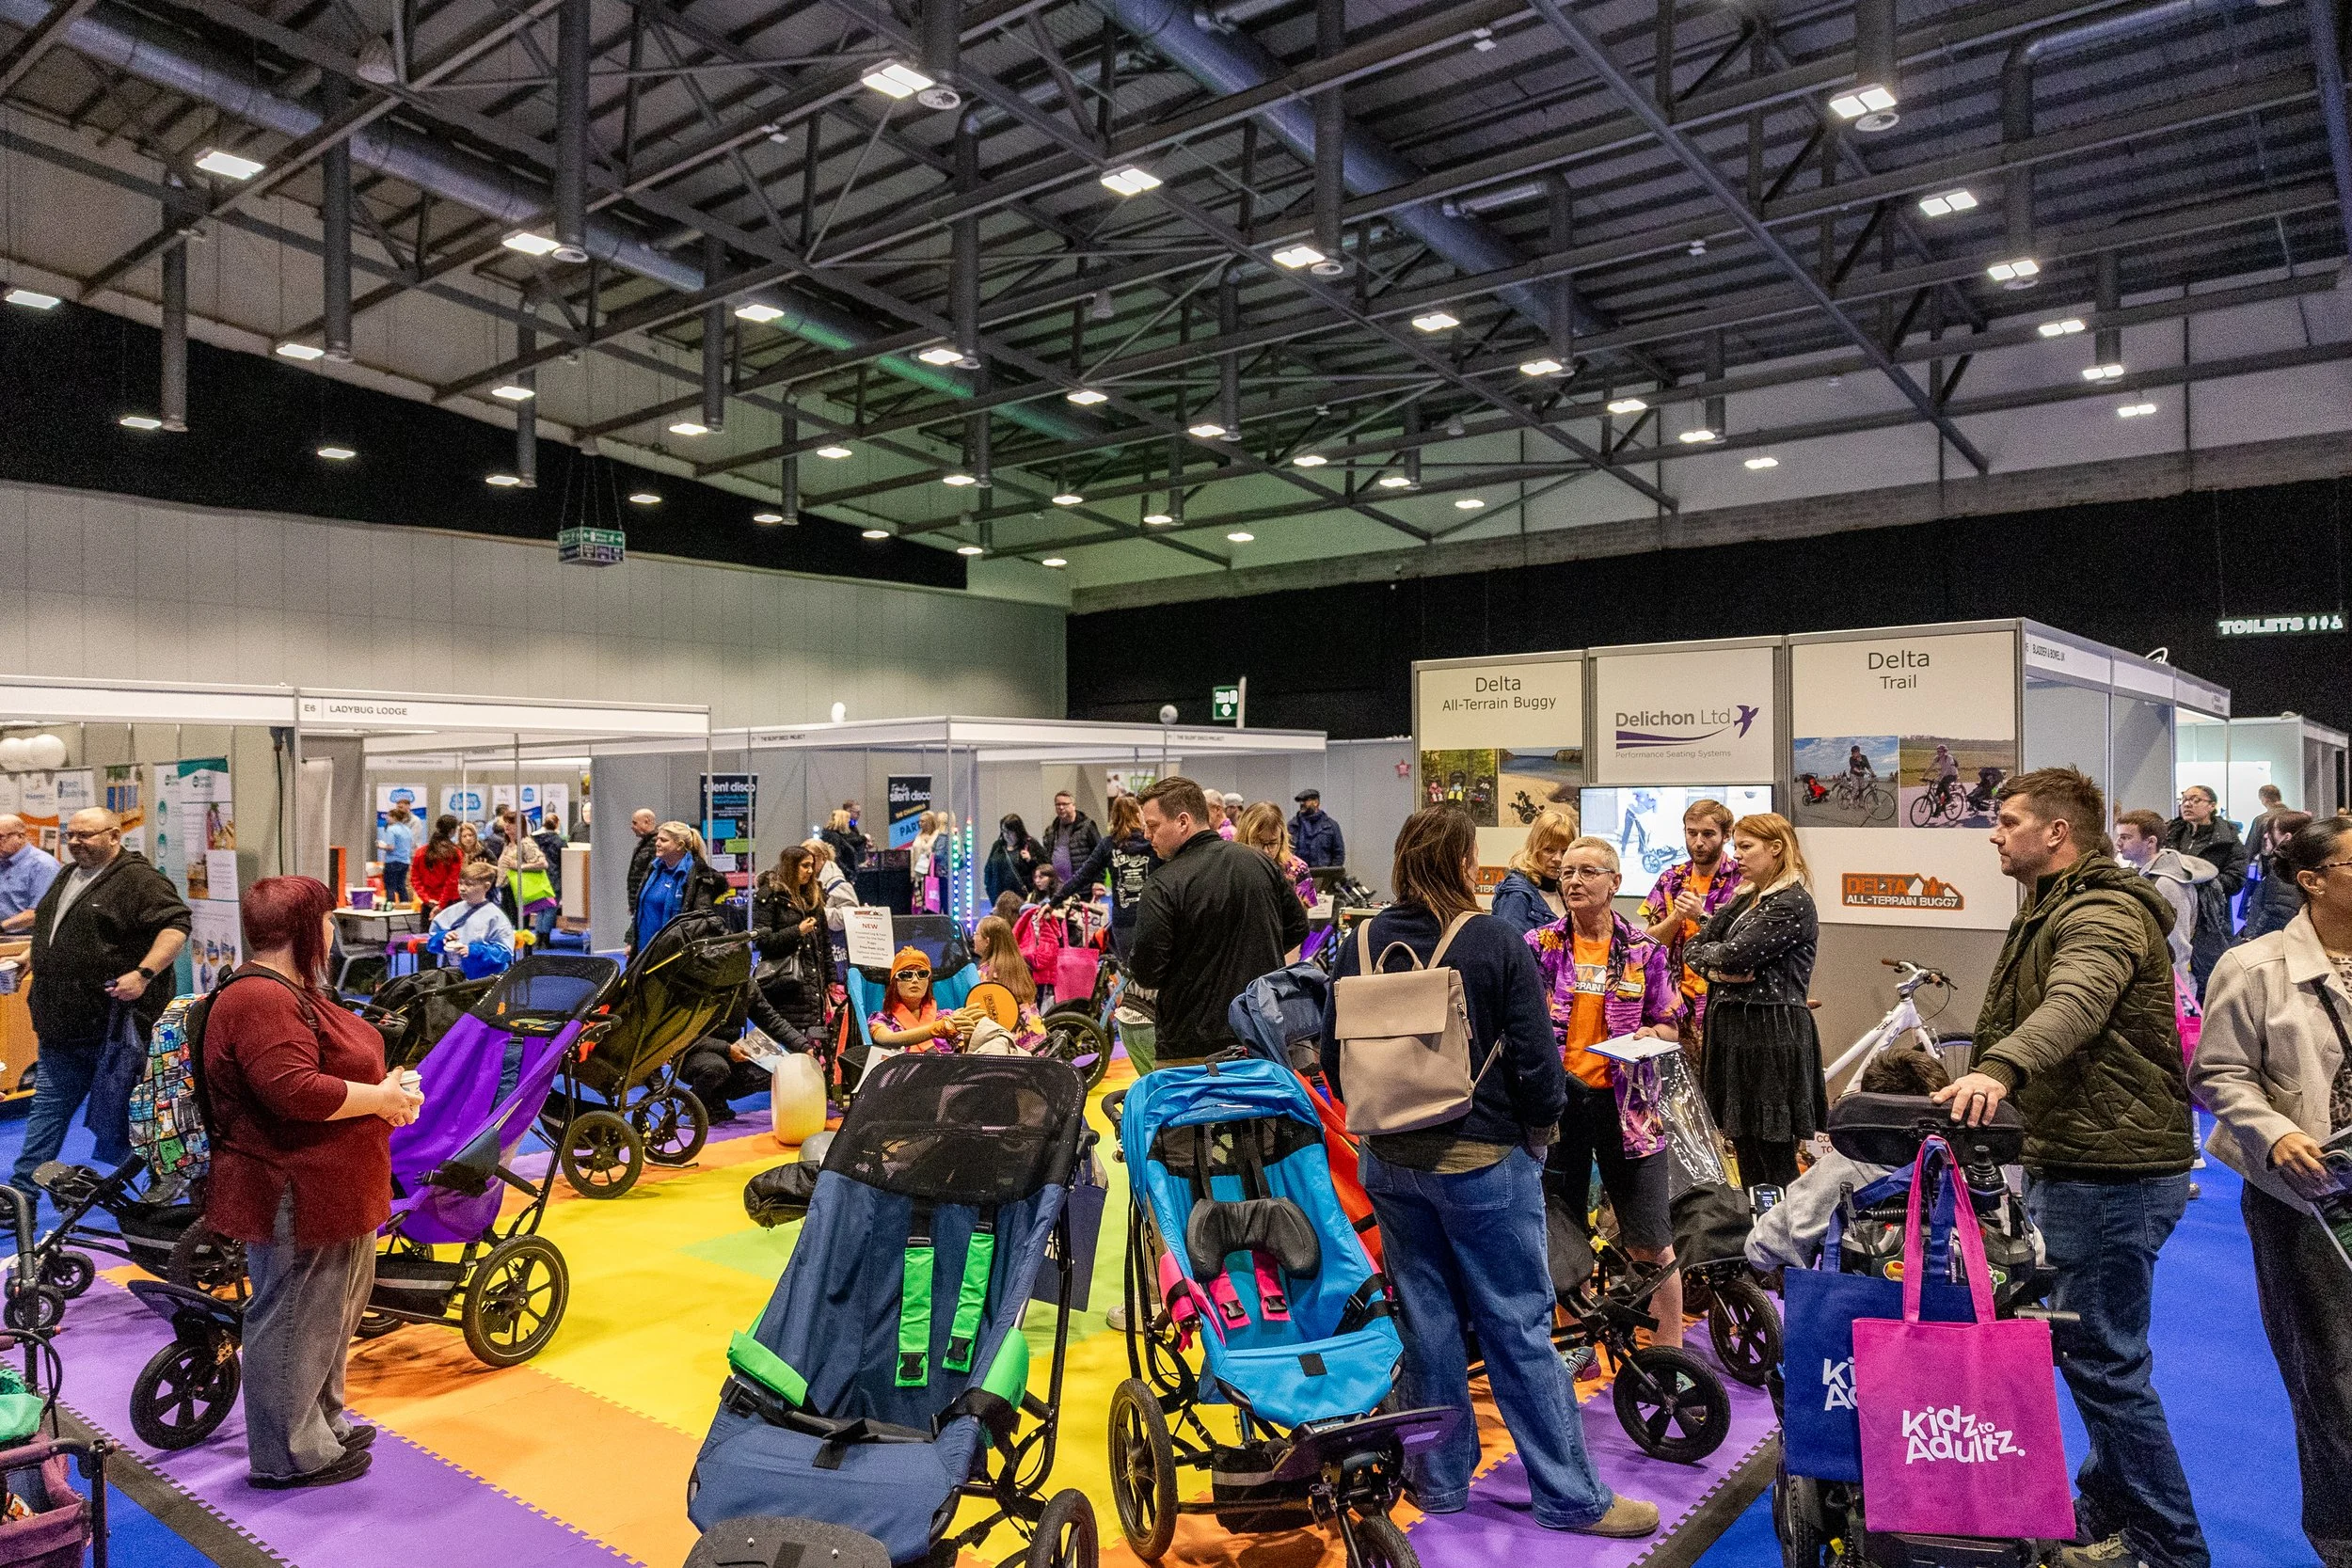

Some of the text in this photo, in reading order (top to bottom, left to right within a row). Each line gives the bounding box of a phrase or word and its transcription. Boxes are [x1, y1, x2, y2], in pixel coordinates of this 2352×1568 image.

[2218, 617, 2304, 634] TOILETS
[1867, 650, 1930, 670] Delta
[1475, 675, 1521, 692] Delta
[1879, 673, 1916, 689] Trail
[304, 704, 316, 712] E6
[329, 705, 408, 716] LADYBUG LODGE
[1442, 696, 1557, 711] All-Terrain Buggy
[1615, 707, 1731, 727] Delichon Ltd
[1666, 751, 1695, 759] Seating
[1698, 750, 1732, 758] Systems
[703, 782, 728, 792] slent
[899, 821, 921, 836] PART
[1846, 877, 1909, 895] DELTA
[1846, 895, 1959, 908] ALL-TERRAIN BUGGY
[1821, 1146, 1834, 1154] TO
[1822, 1356, 1857, 1389] Ki
[1902, 1405, 1995, 1440] Kidz to
[1905, 1430, 2026, 1465] Adultz.
